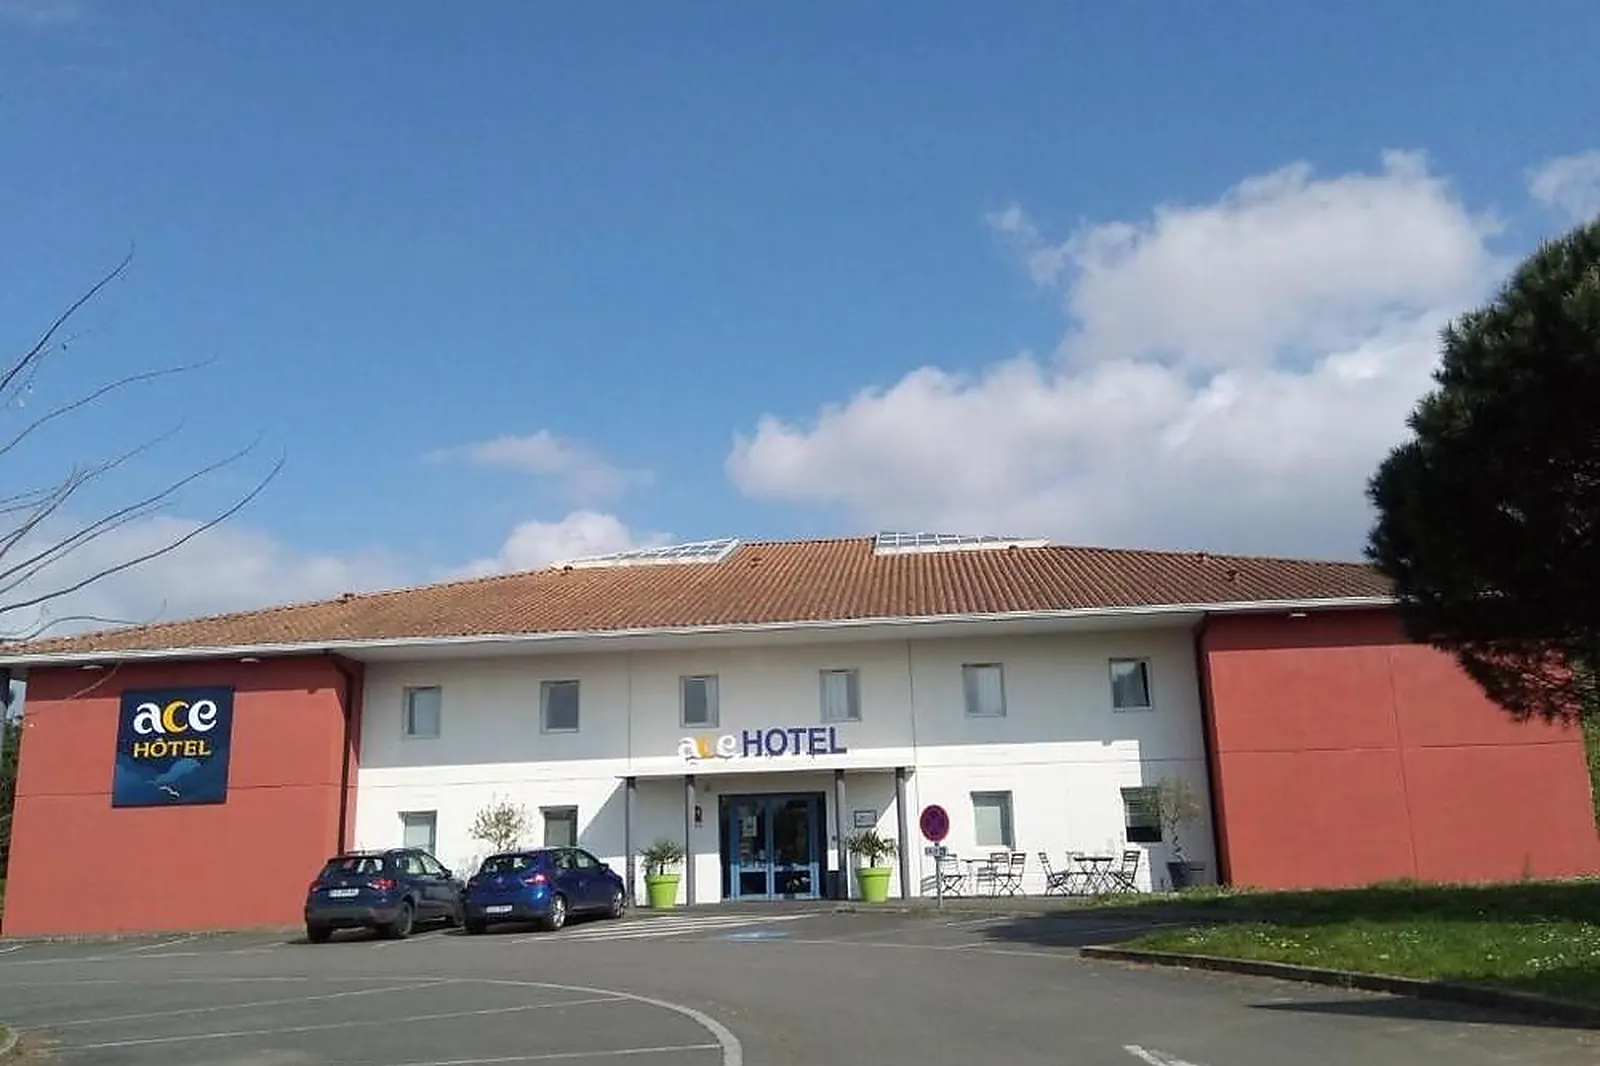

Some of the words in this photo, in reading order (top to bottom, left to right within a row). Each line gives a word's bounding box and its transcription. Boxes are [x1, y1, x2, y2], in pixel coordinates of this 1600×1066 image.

[133, 700, 217, 734] ace
[678, 735, 737, 760] ace
[742, 726, 848, 758] HOTEL
